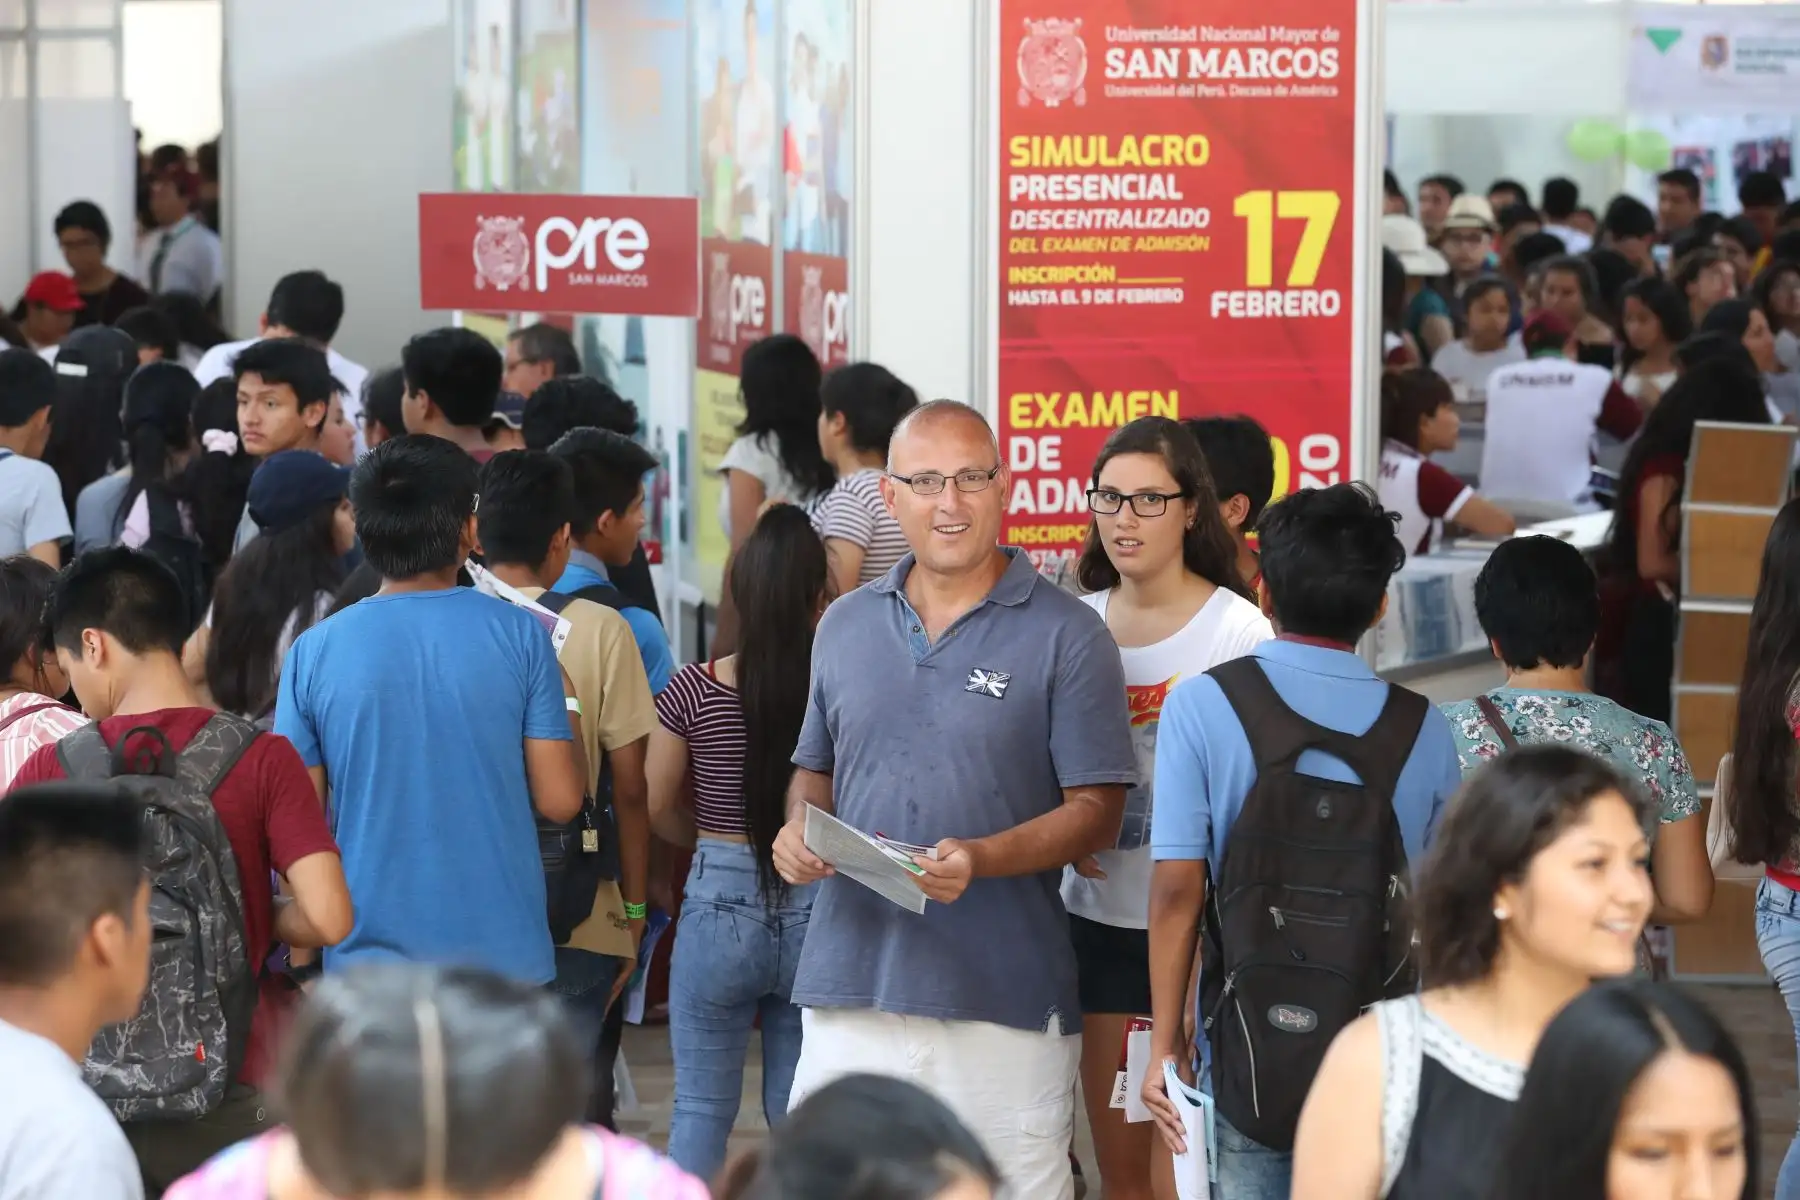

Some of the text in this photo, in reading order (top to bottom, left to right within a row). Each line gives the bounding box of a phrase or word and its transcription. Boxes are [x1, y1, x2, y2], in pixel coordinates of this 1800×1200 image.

[1105, 26, 1340, 45] Universidad Nacional Mayor de
[1104, 47, 1340, 79] SAN MARCOS
[1104, 84, 1176, 98] Universidad
[1178, 84, 1194, 98] del
[1274, 84, 1288, 98] de
[1009, 134, 1210, 167] SIMULACRO
[1009, 173, 1184, 202] PRESENCIAL
[1009, 207, 1211, 230] DESCENTRALIZADO
[1009, 233, 1211, 253] DEL EXAMEN DE ADMISIÓN
[1233, 189, 1341, 288] 17
[535, 216, 649, 293] pre
[568, 272, 648, 288] SAN MARCOS
[1008, 262, 1116, 285] INSCRIPCIÓN
[729, 273, 766, 344] pre
[1008, 288, 1184, 306] HASTA EL 9 DE FEBRERO
[1210, 289, 1340, 319] FEBRERO
[1009, 390, 1179, 429] EXAMEN
[1009, 435, 1062, 473] DE
[1008, 478, 1094, 515] ADM
[1008, 523, 1088, 544] INSCRIPC
